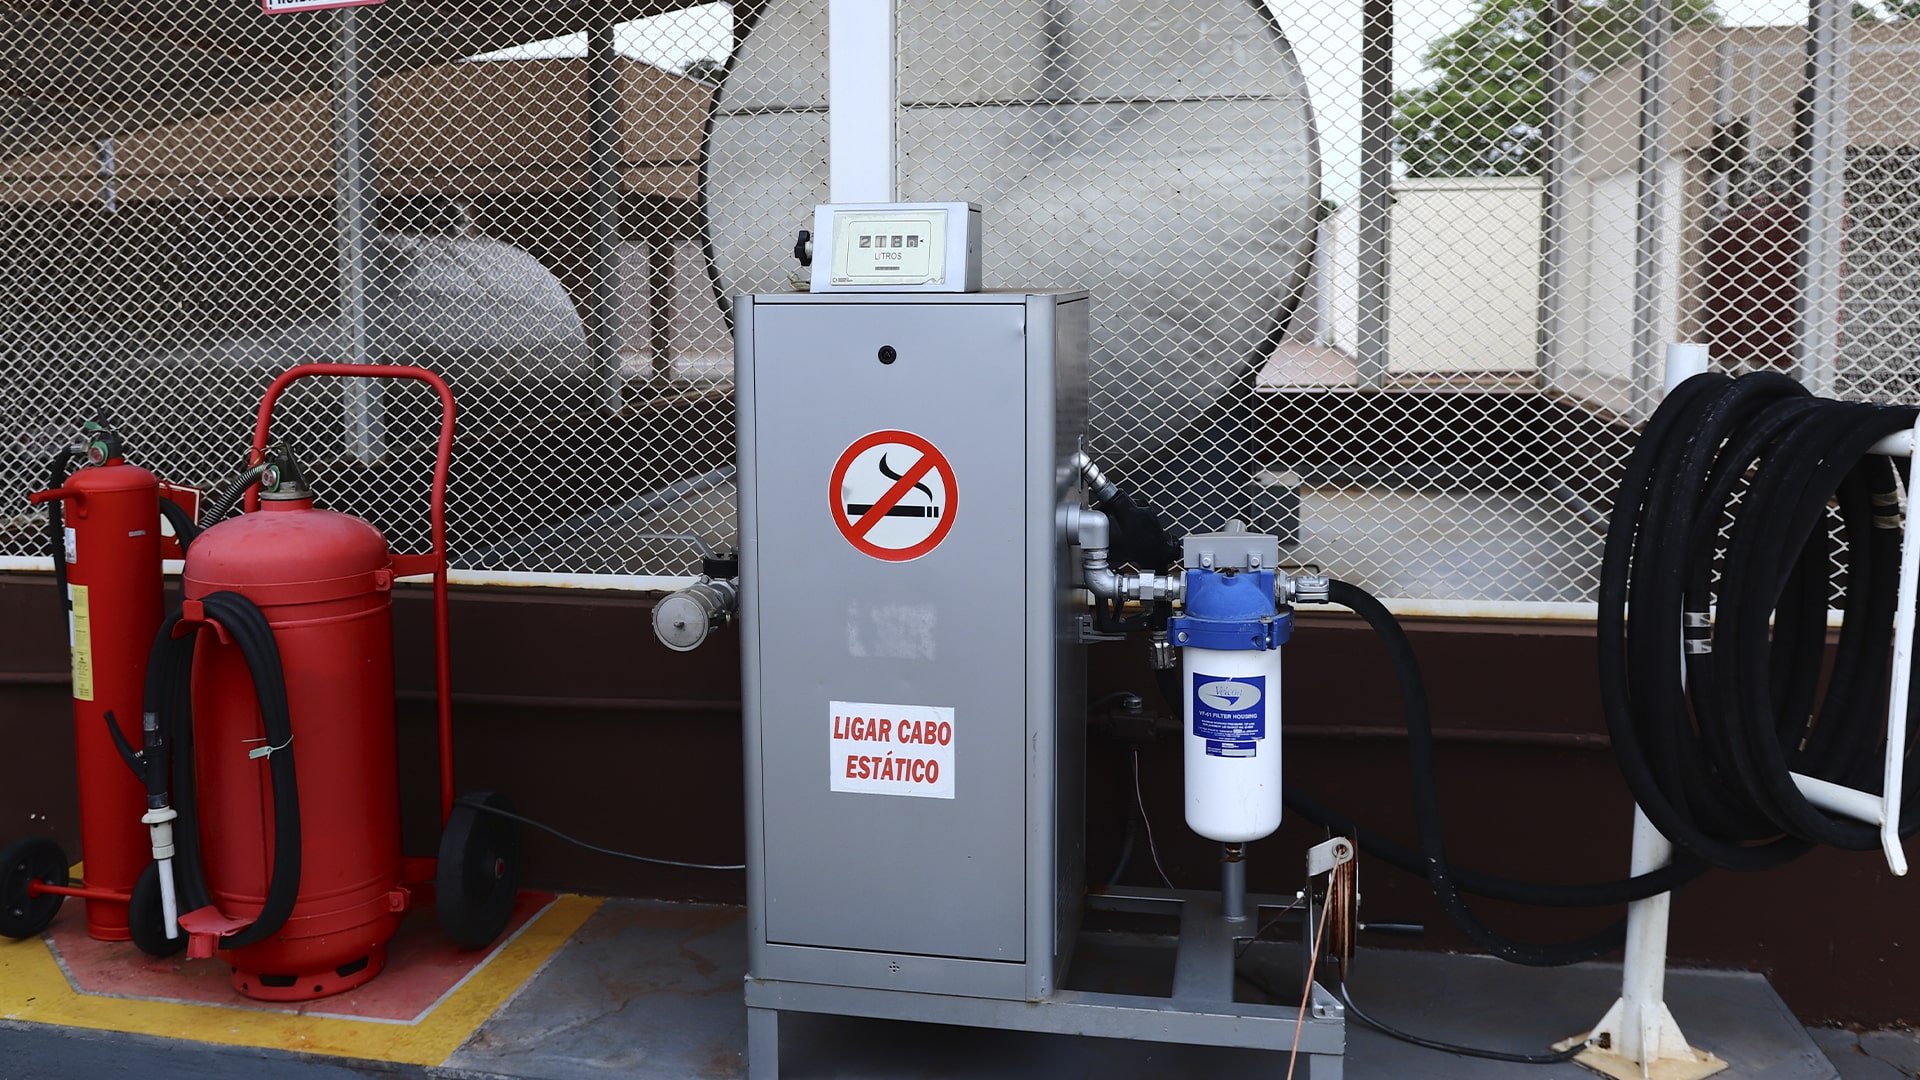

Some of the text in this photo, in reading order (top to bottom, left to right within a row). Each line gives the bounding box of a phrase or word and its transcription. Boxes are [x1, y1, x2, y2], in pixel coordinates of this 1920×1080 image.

[874, 252, 902, 260] LITROS
[833, 716, 952, 746] LIGAR CABO
[845, 750, 940, 784] ESTÁTICO
